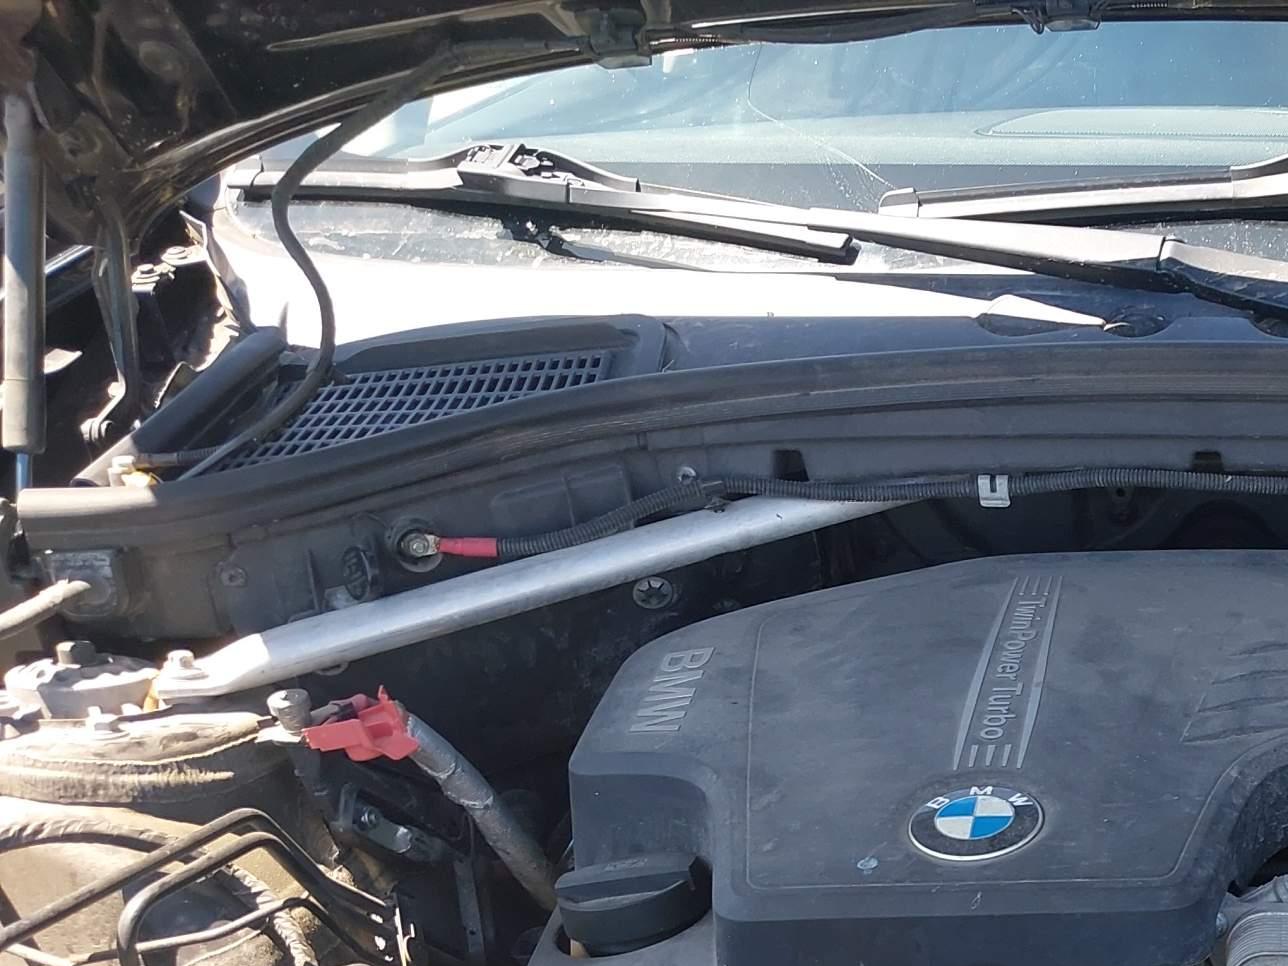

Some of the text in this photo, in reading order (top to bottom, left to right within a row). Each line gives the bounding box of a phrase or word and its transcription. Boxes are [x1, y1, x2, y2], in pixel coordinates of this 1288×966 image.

[629, 647, 714, 732] BMW
[980, 599, 1046, 740] TwinPower Turbo
[926, 786, 1033, 809] BMW
